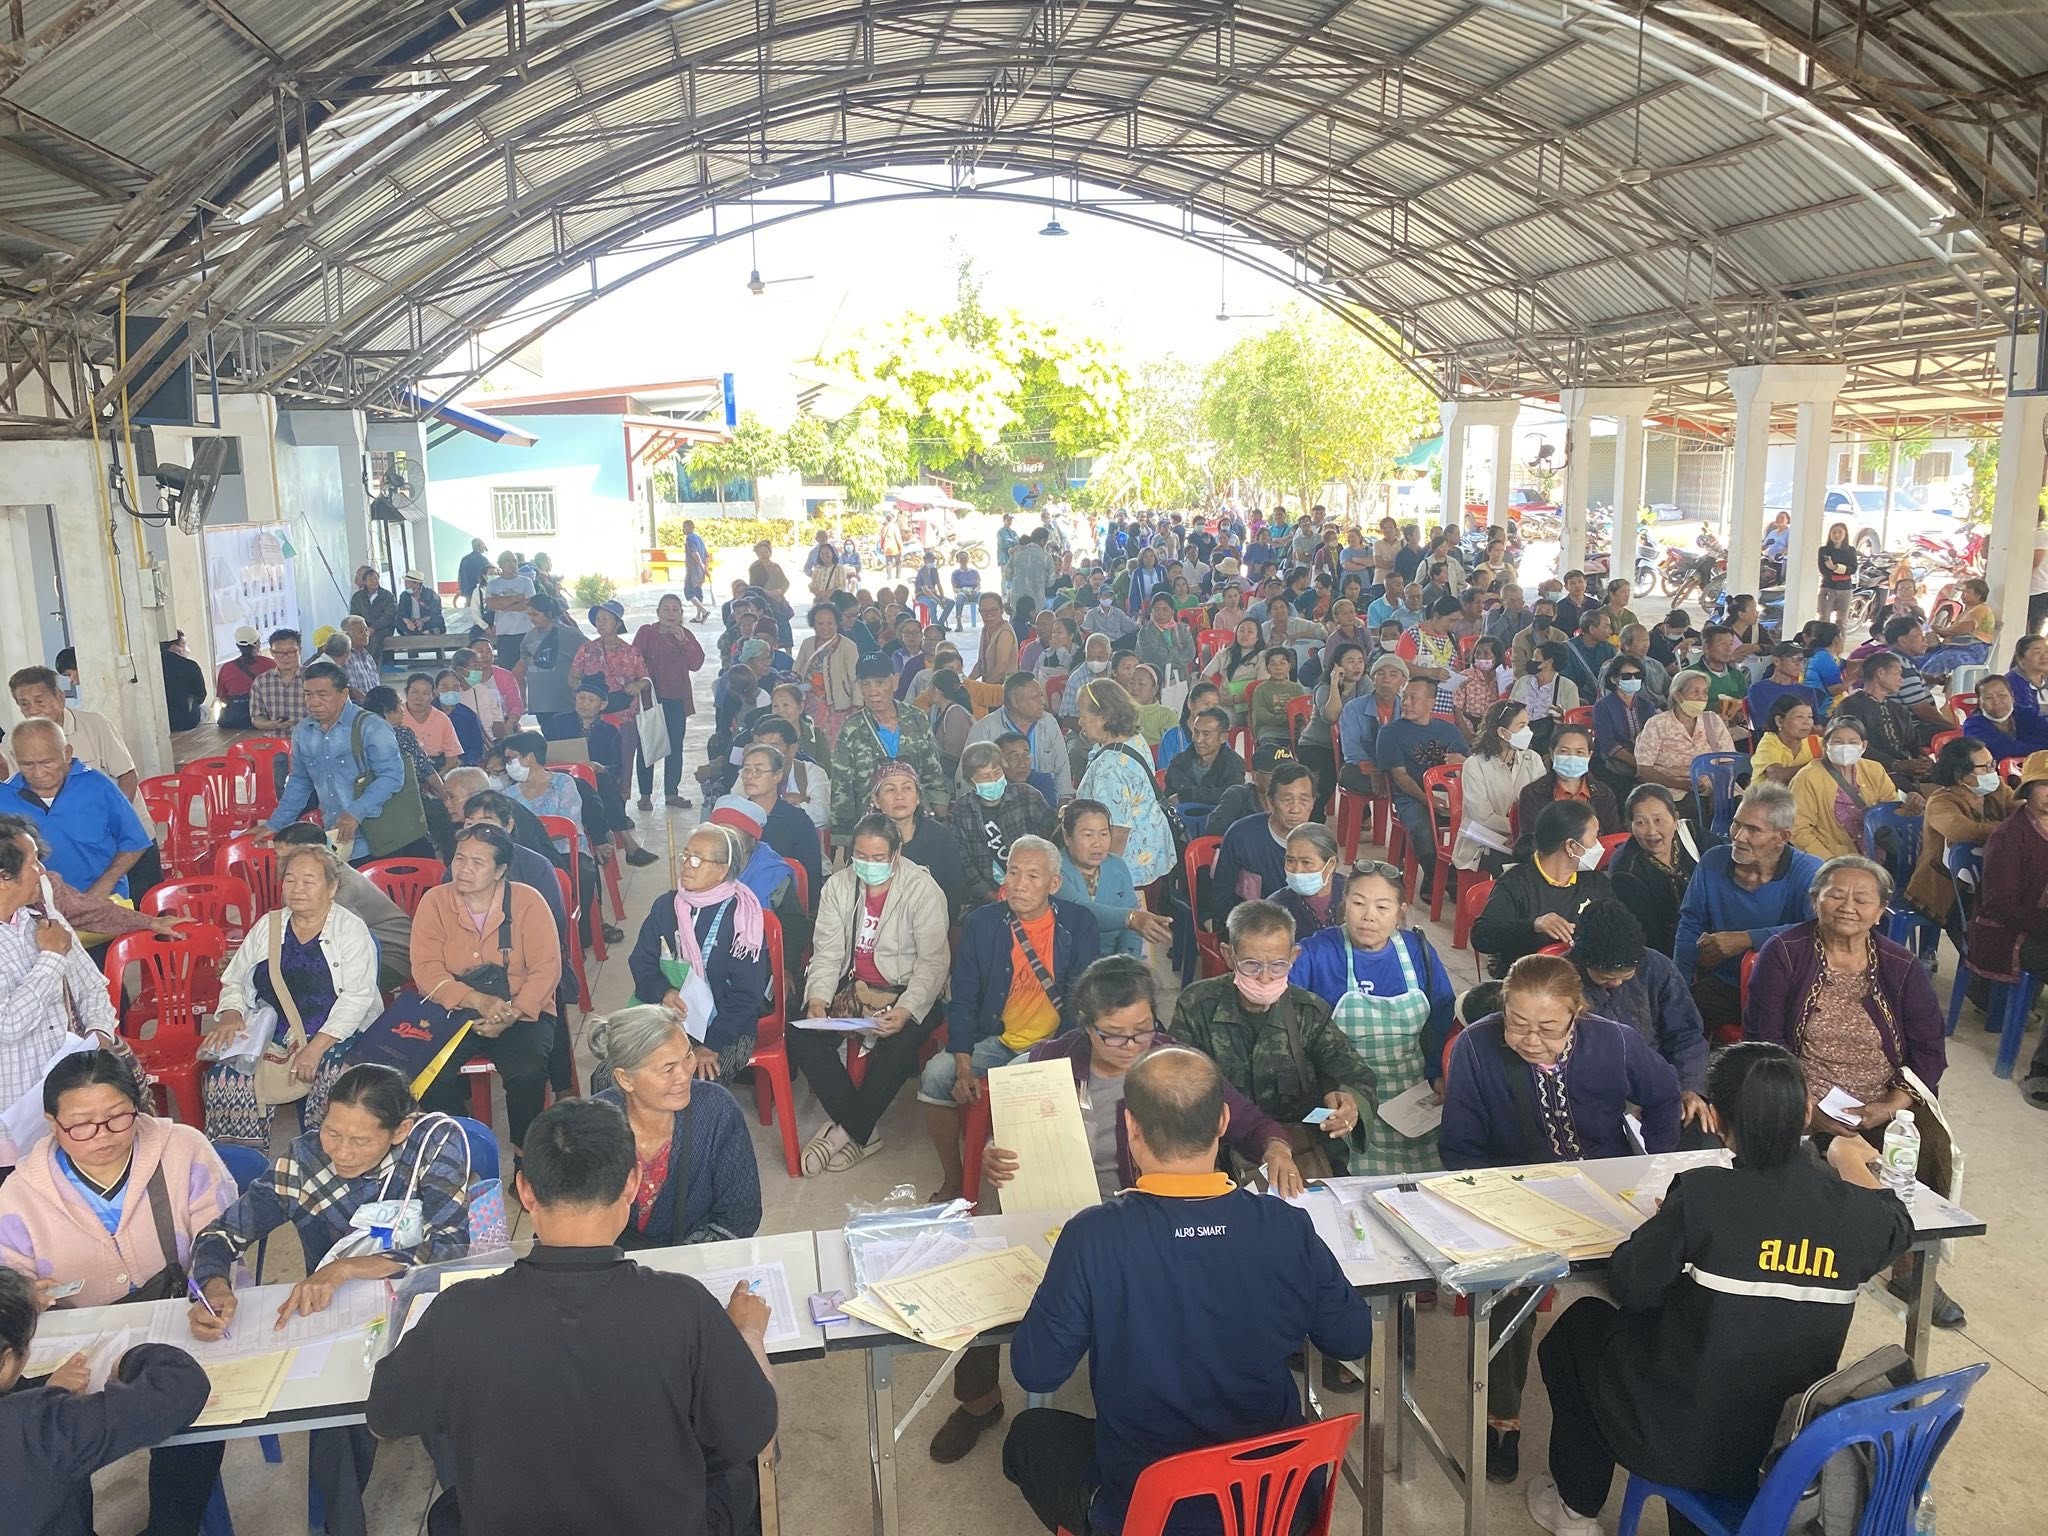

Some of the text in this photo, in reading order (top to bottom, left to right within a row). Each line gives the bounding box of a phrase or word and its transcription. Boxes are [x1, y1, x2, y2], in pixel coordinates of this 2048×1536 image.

[1174, 1225, 1227, 1238] ALRO SMART
[1758, 1238, 1839, 1279] ส.ป.ก.
